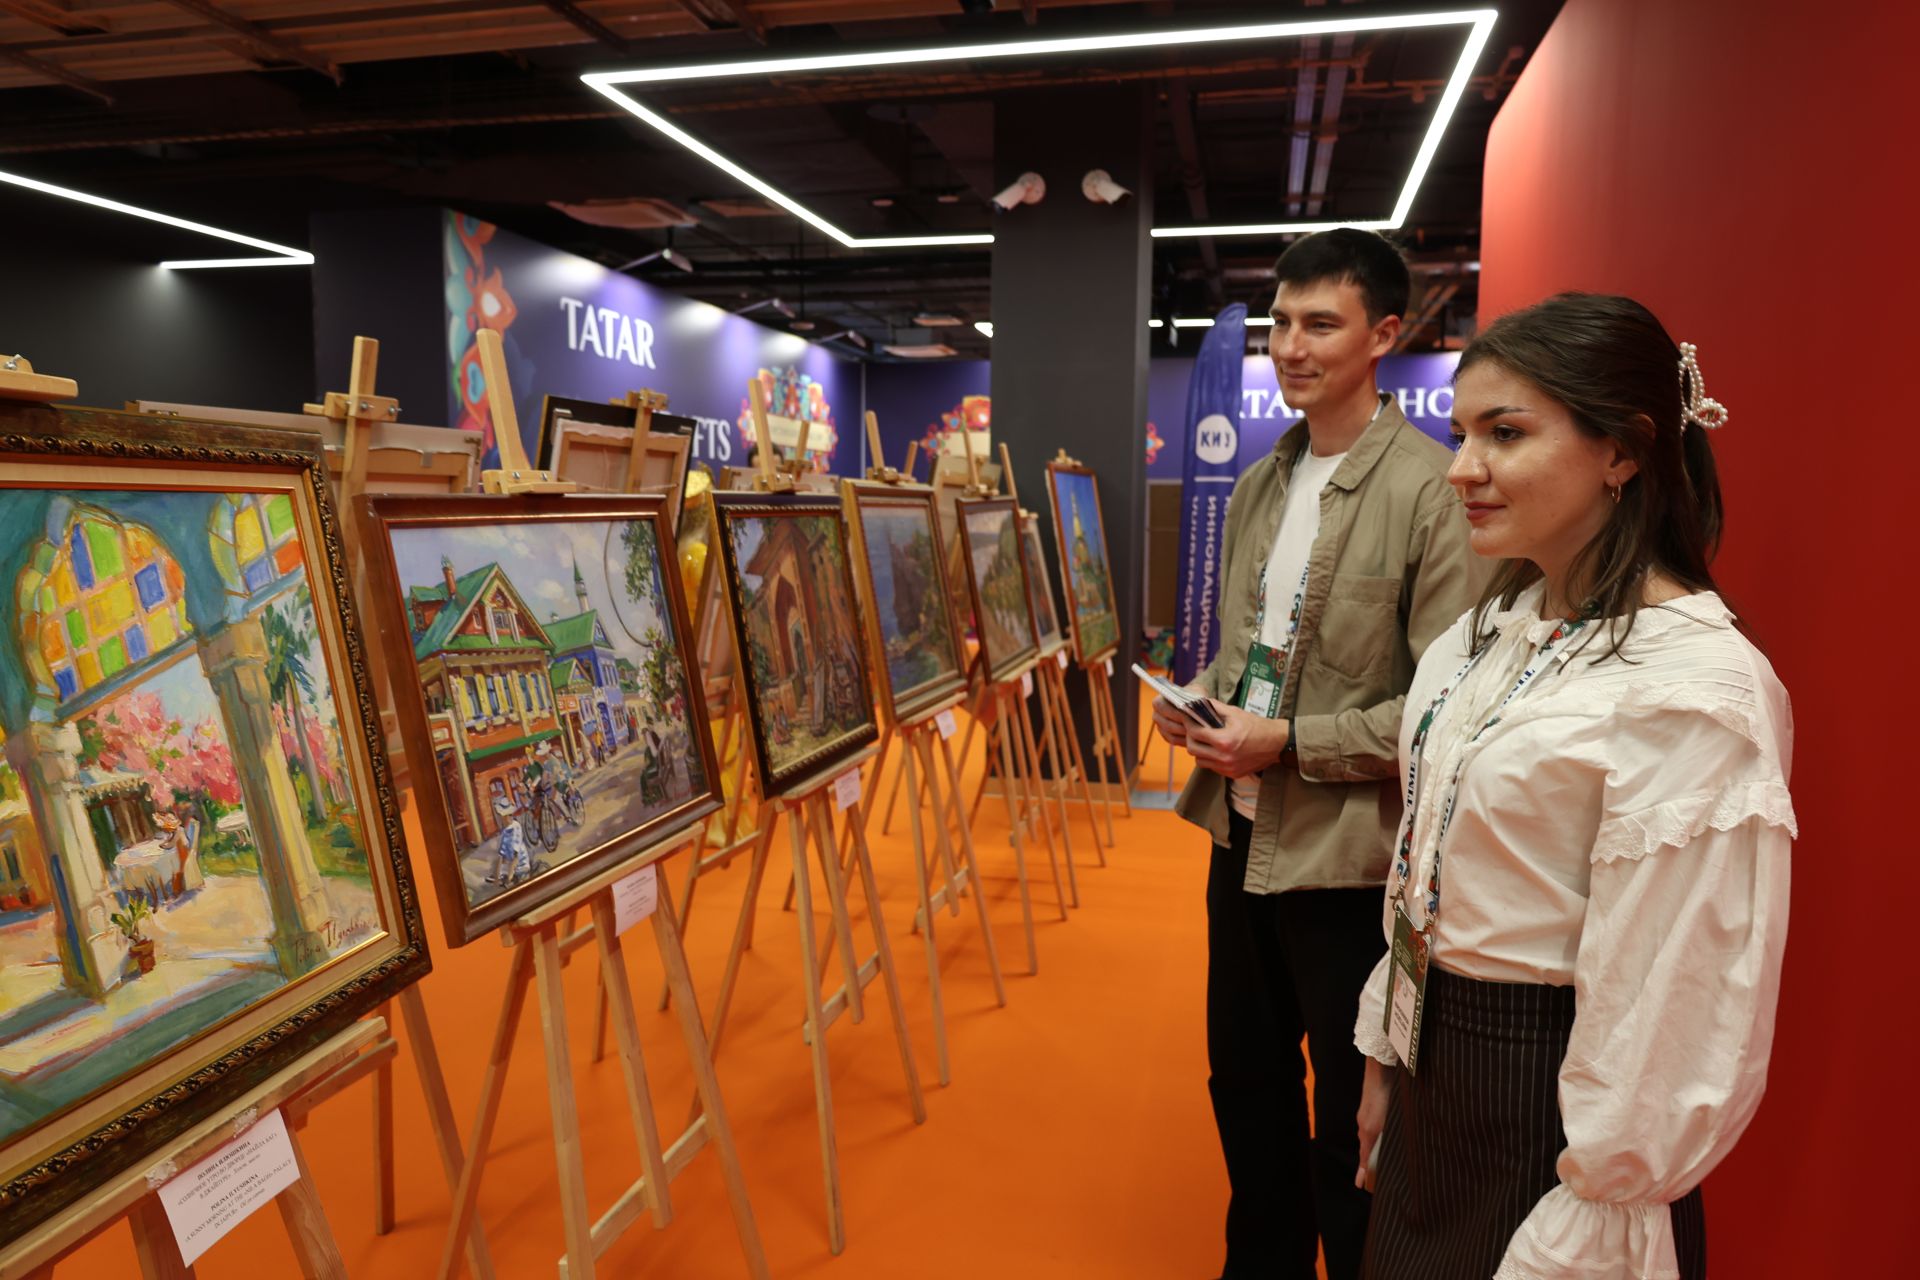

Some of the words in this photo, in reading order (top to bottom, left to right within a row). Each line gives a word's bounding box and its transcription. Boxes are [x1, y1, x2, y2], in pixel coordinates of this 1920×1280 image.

[559, 297, 656, 370] TATAR
[682, 413, 732, 462] FTS
[1195, 495, 1217, 676] ИННОВАЦИОНН
[1406, 761, 1416, 807] TIME
[210, 1194, 229, 1211] POLINA
